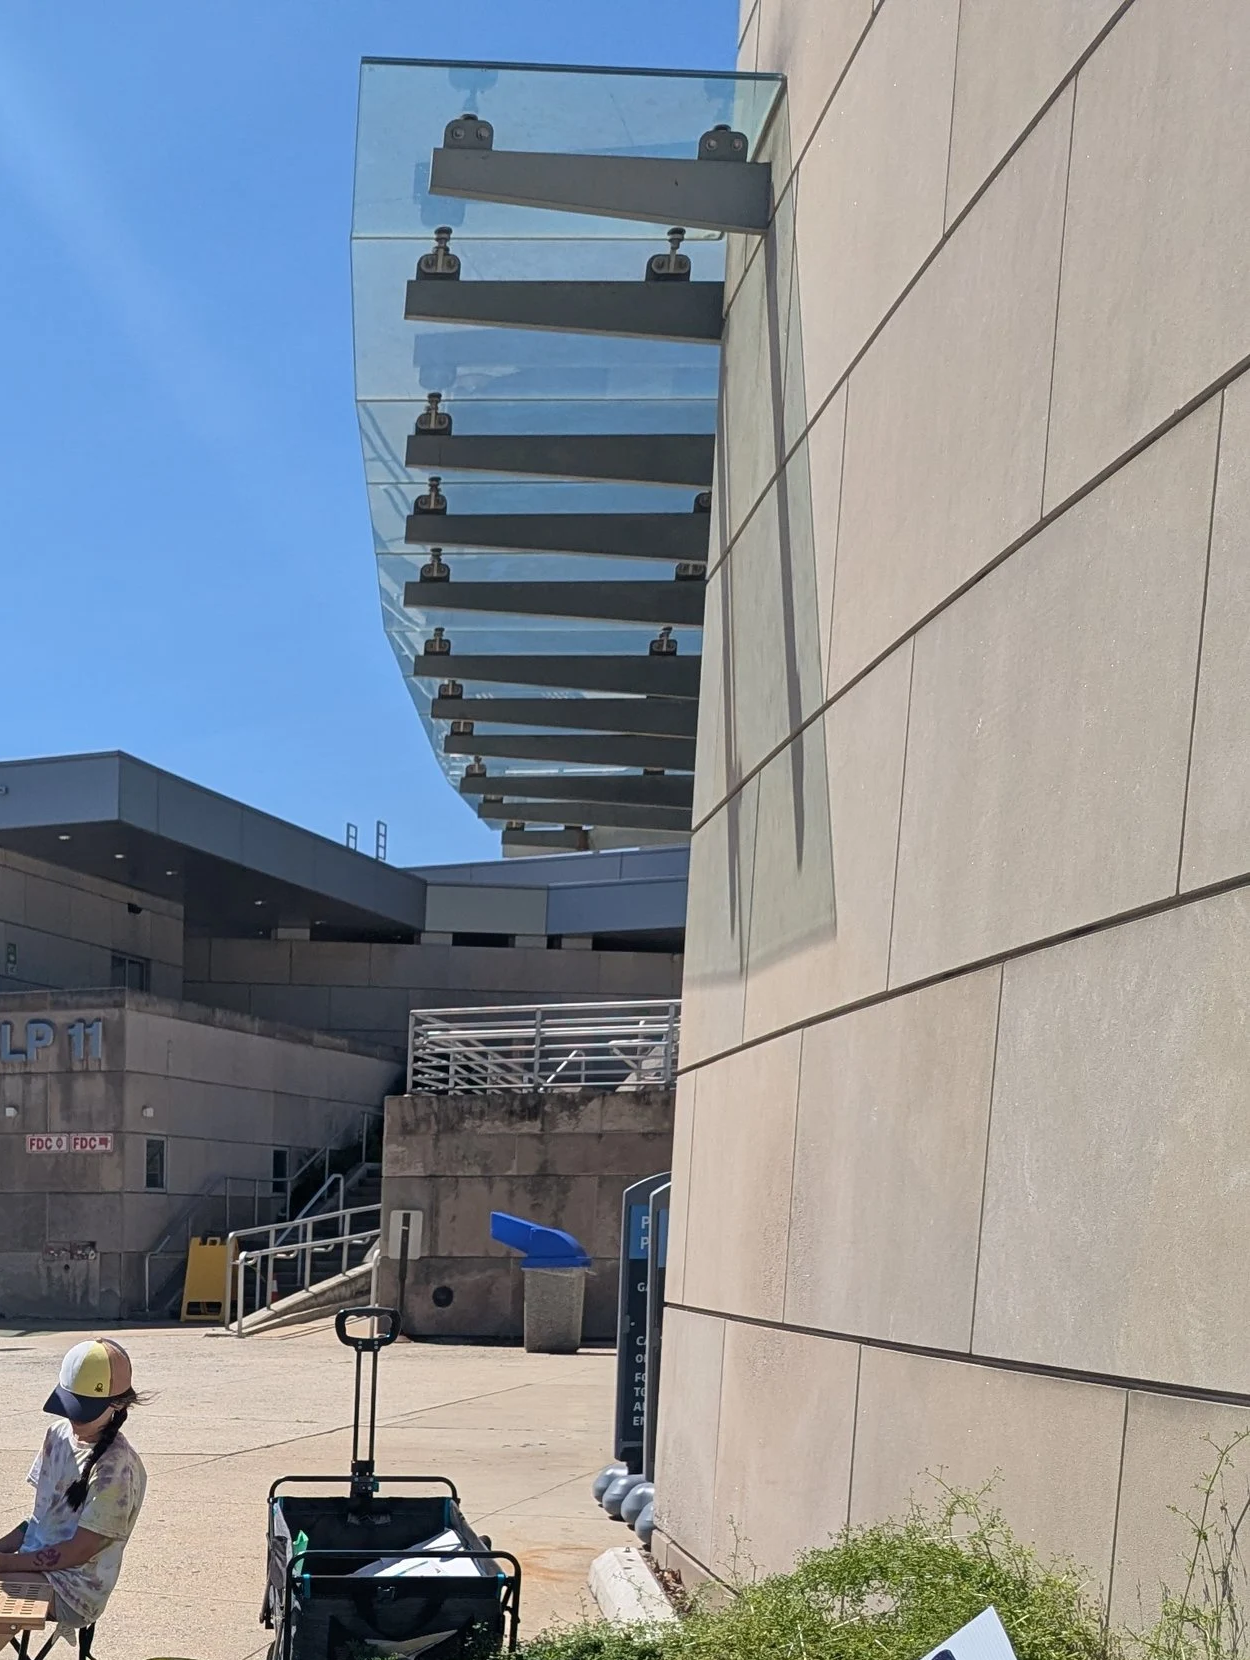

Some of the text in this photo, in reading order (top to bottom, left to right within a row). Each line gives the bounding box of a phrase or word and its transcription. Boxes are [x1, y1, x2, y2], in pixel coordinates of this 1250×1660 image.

[67, 1017, 103, 1060] 11
[28, 1136, 53, 1151] FDC
[72, 1136, 98, 1151] FDC
